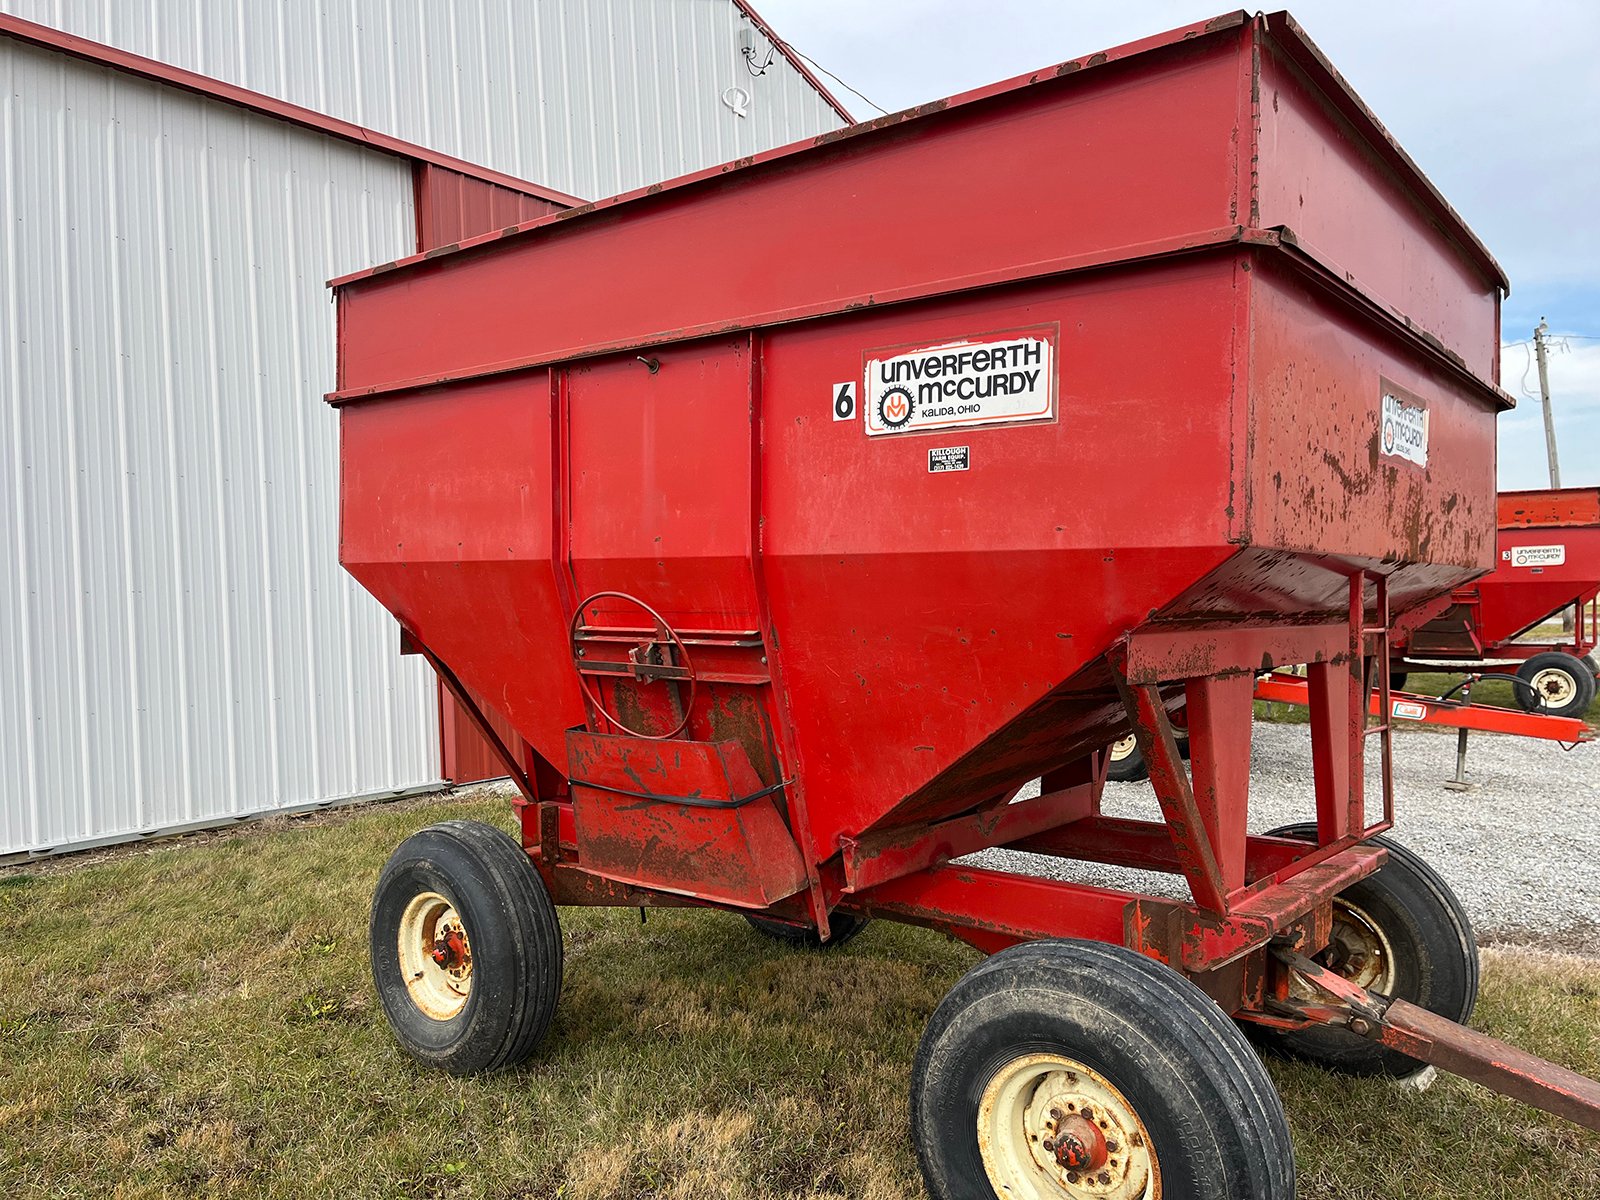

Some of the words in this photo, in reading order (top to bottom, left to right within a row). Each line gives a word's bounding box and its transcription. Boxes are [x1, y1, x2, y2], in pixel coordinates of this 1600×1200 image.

[835, 383, 853, 418] 6
[957, 403, 981, 415] OHIO
[932, 448, 966, 457] KILLOUGH
[1503, 551, 1510, 560] 3
